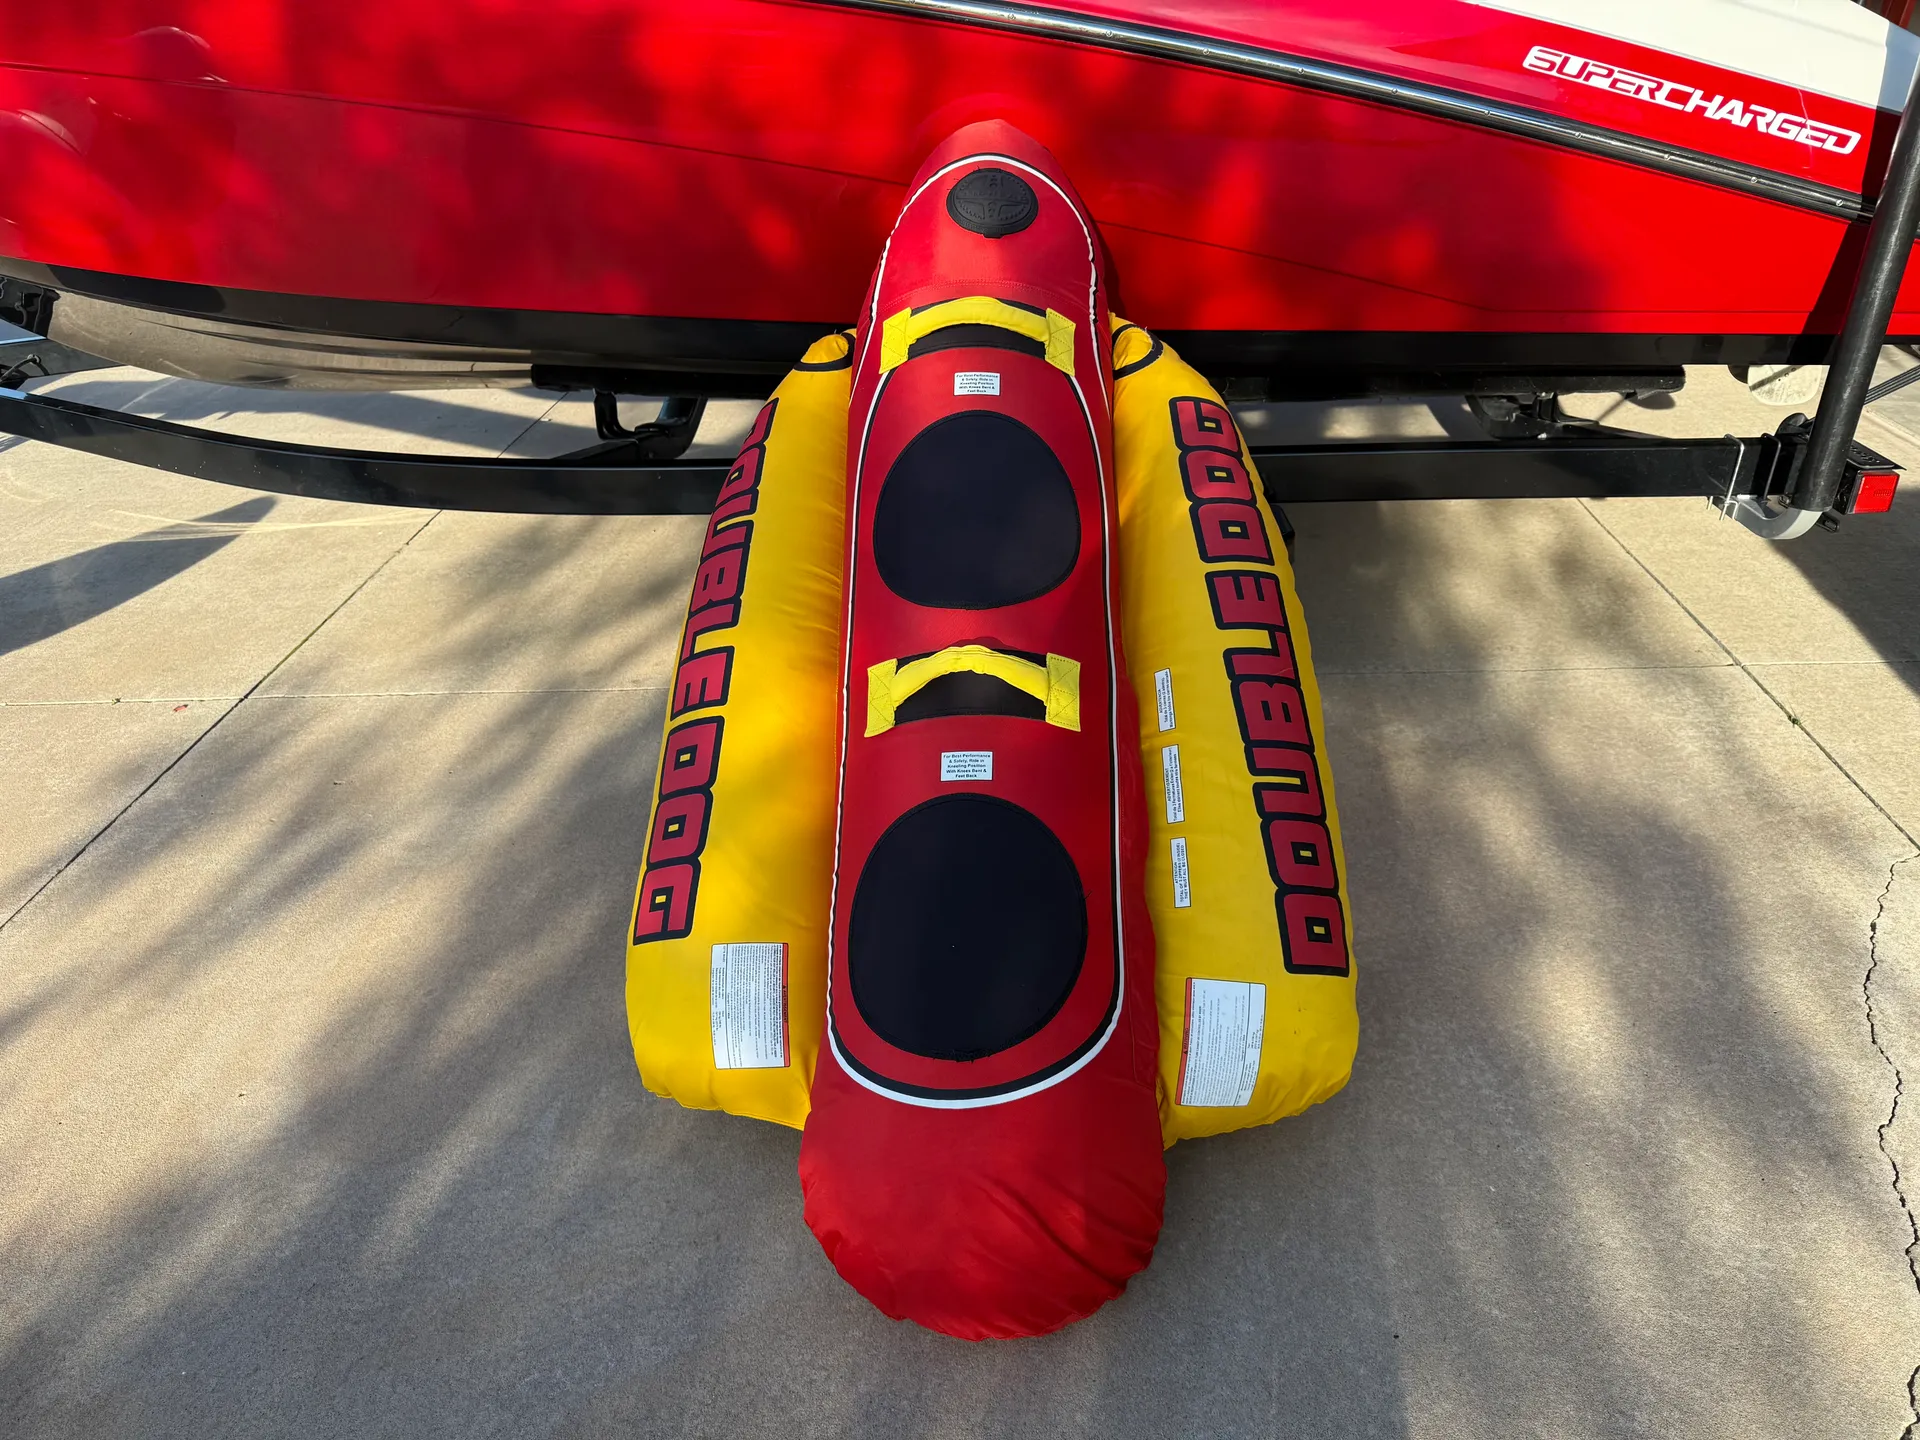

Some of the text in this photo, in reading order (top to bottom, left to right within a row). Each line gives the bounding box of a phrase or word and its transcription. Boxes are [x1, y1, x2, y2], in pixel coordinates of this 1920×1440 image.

[1522, 45, 1861, 155] SUPERCHARGED
[1169, 395, 1274, 567] DOG
[633, 715, 725, 945] DOG
[1204, 569, 1349, 976] DOUBLE
